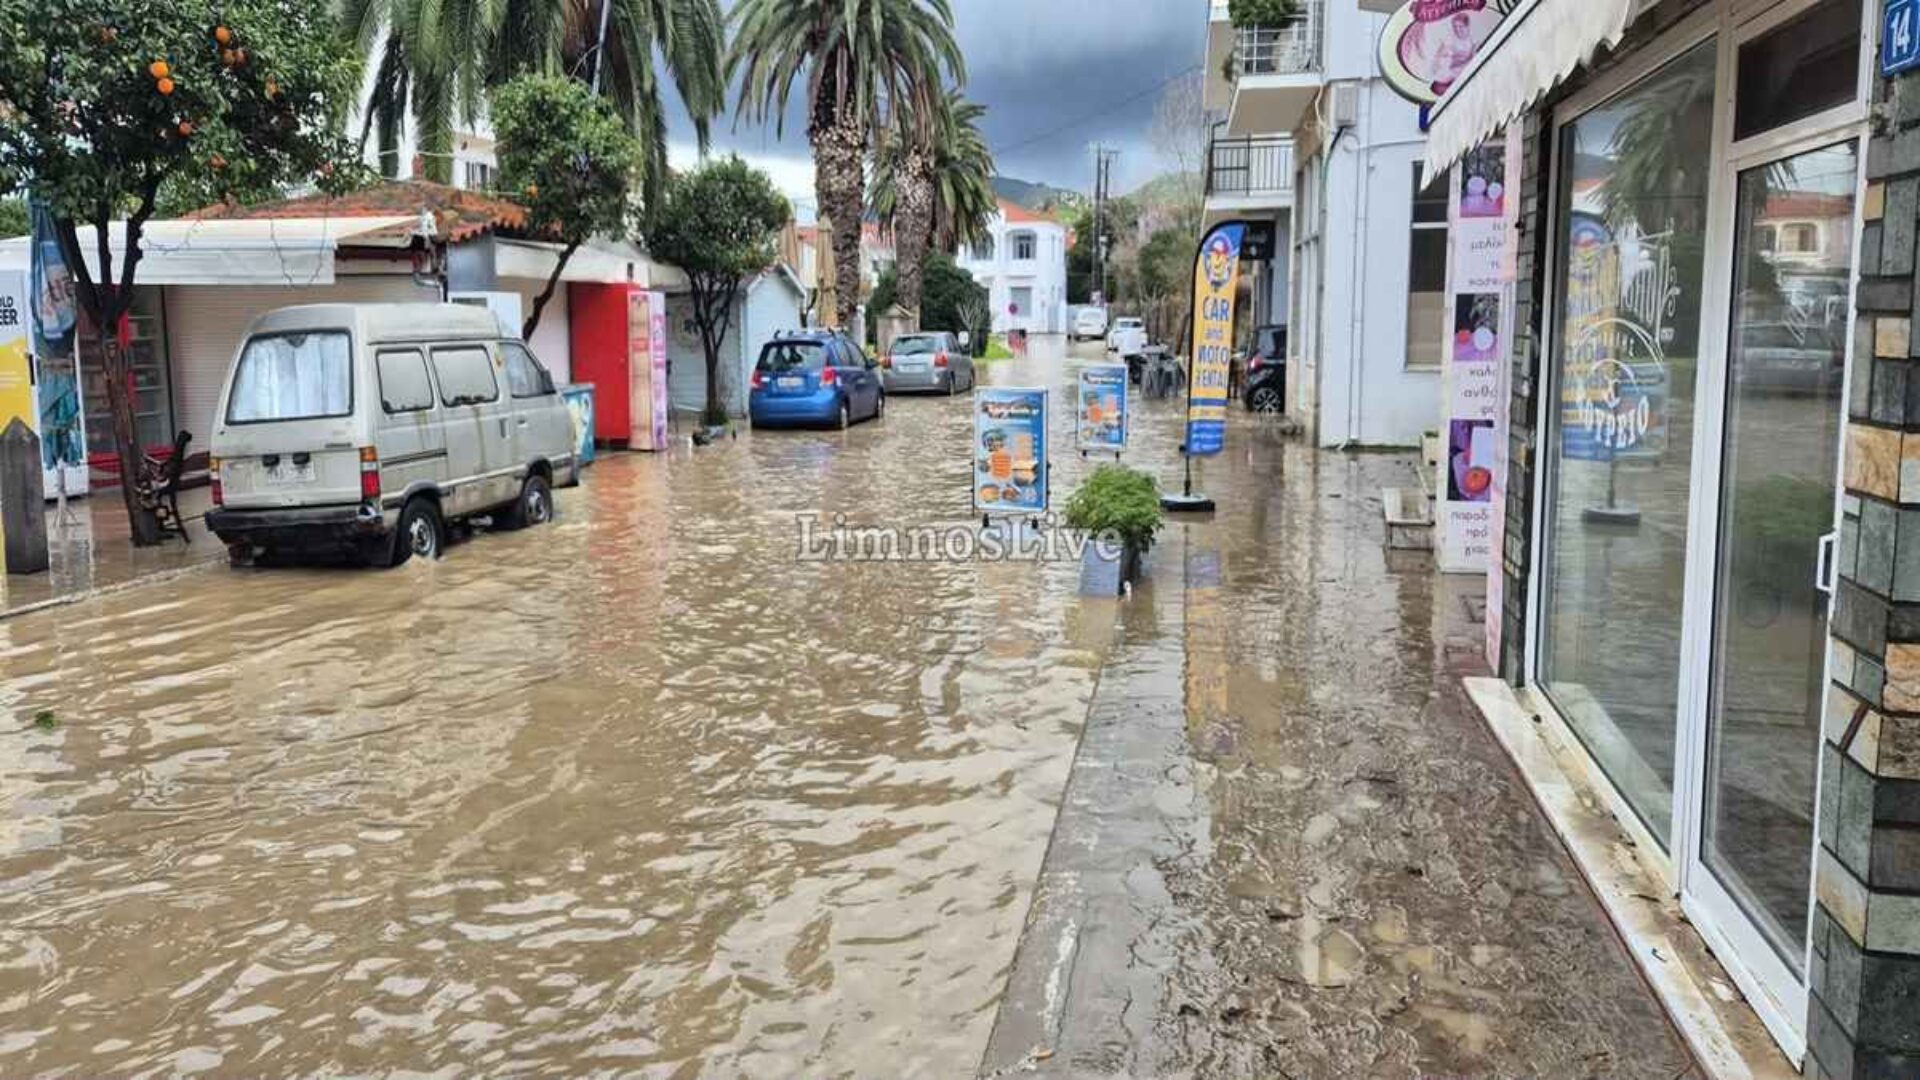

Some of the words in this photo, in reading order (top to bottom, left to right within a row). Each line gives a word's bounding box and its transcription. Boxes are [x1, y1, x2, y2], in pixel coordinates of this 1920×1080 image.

[1890, 7, 1911, 58] 14
[1202, 296, 1230, 321] CAR
[1197, 345, 1230, 365] MOTO
